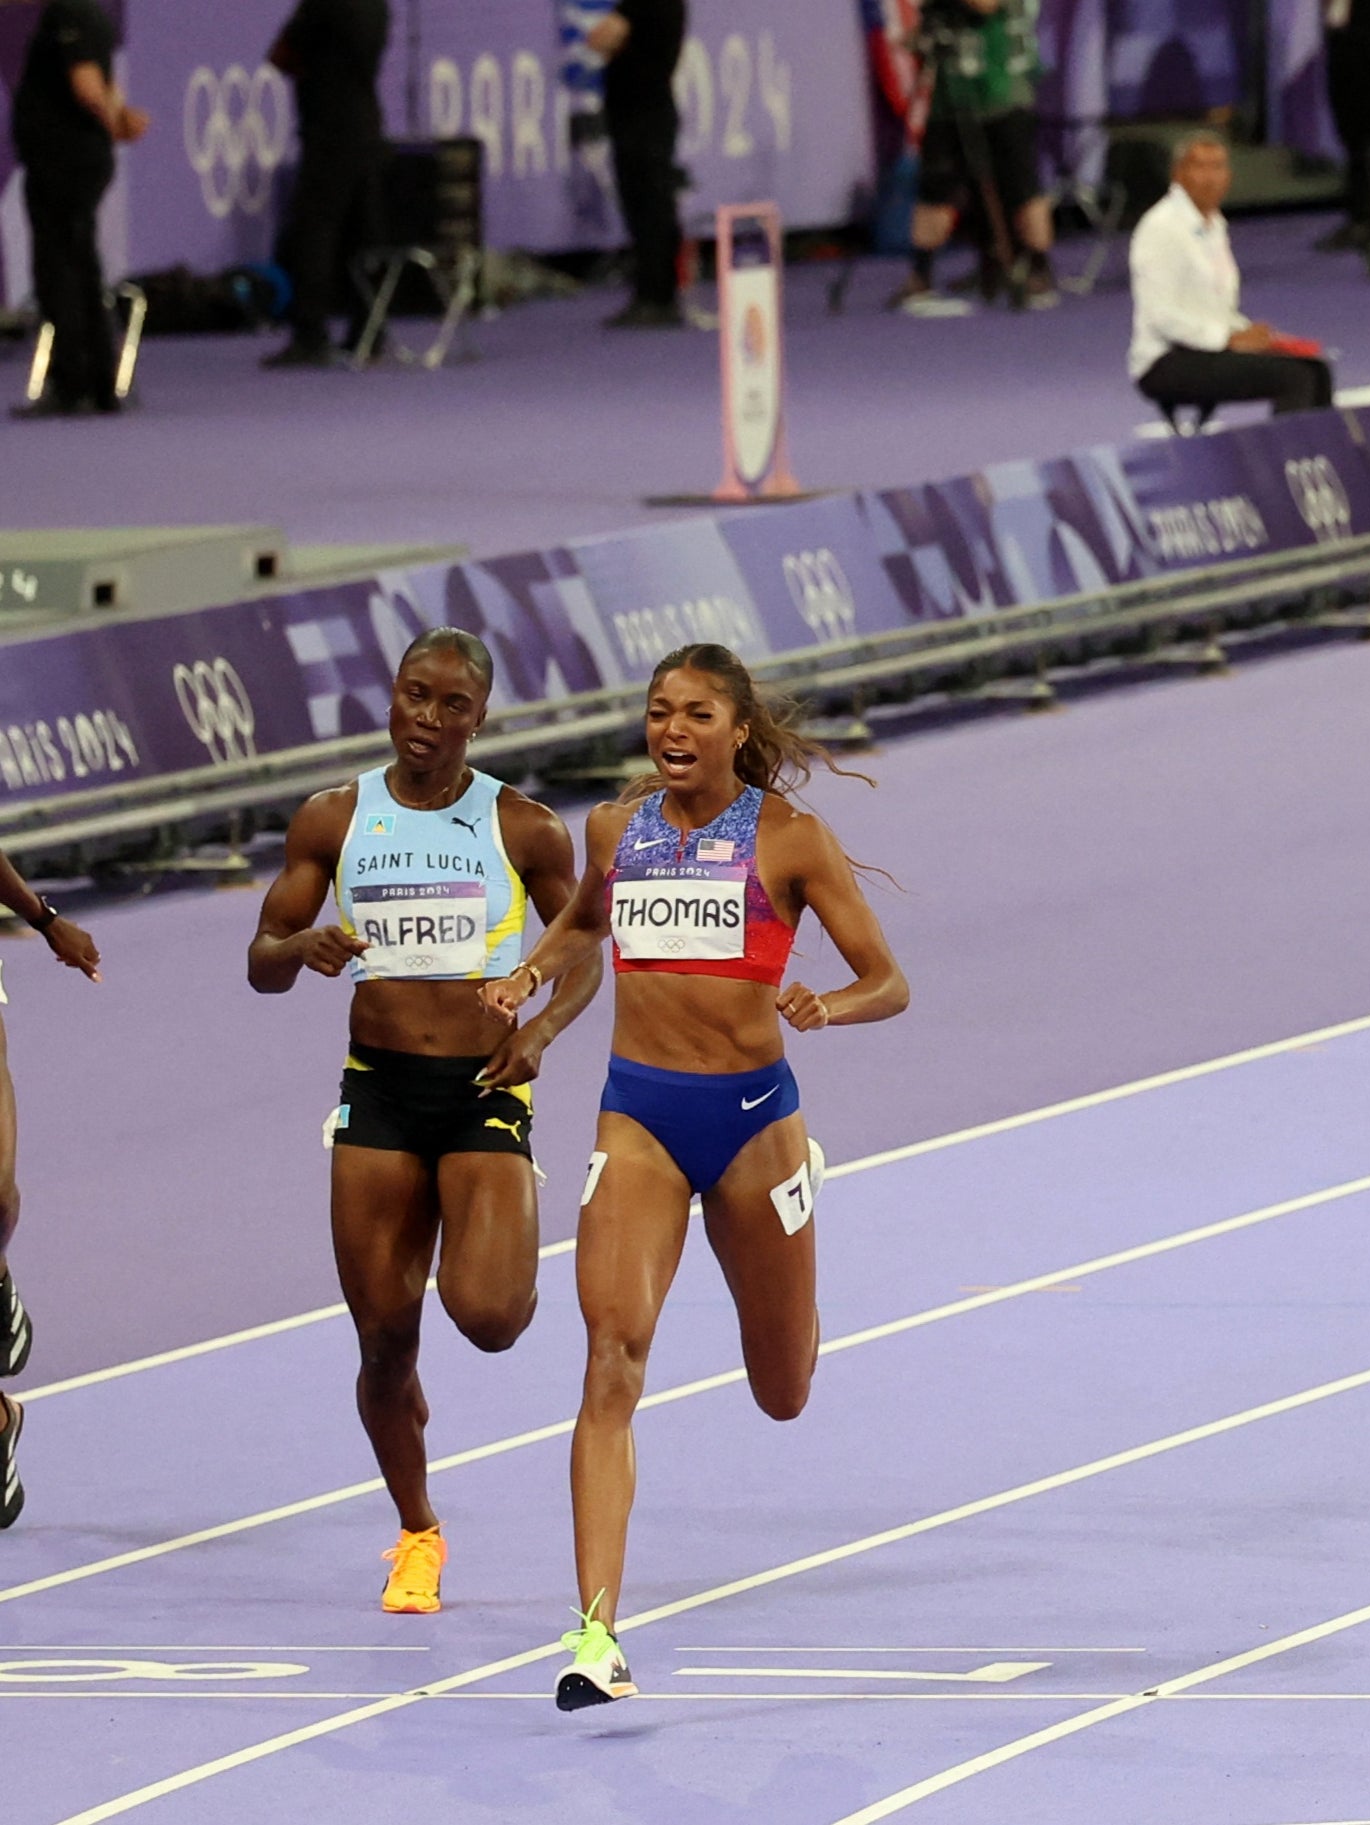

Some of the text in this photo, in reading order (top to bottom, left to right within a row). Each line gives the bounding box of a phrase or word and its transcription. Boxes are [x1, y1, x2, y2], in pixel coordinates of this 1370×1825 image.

[428, 30, 793, 180] PARI 024
[0, 567, 38, 602] 4
[56, 708, 140, 779] 2024
[357, 852, 485, 877] SAINT LUCIA
[645, 867, 711, 877] PARIS 2024
[381, 886, 450, 897] PARIS 2024
[616, 898, 740, 928] THOMAS
[364, 915, 476, 947] ALFRED
[788, 1181, 806, 1213] 7
[0, 1659, 310, 1682] 8
[671, 1662, 1052, 1683] 7
